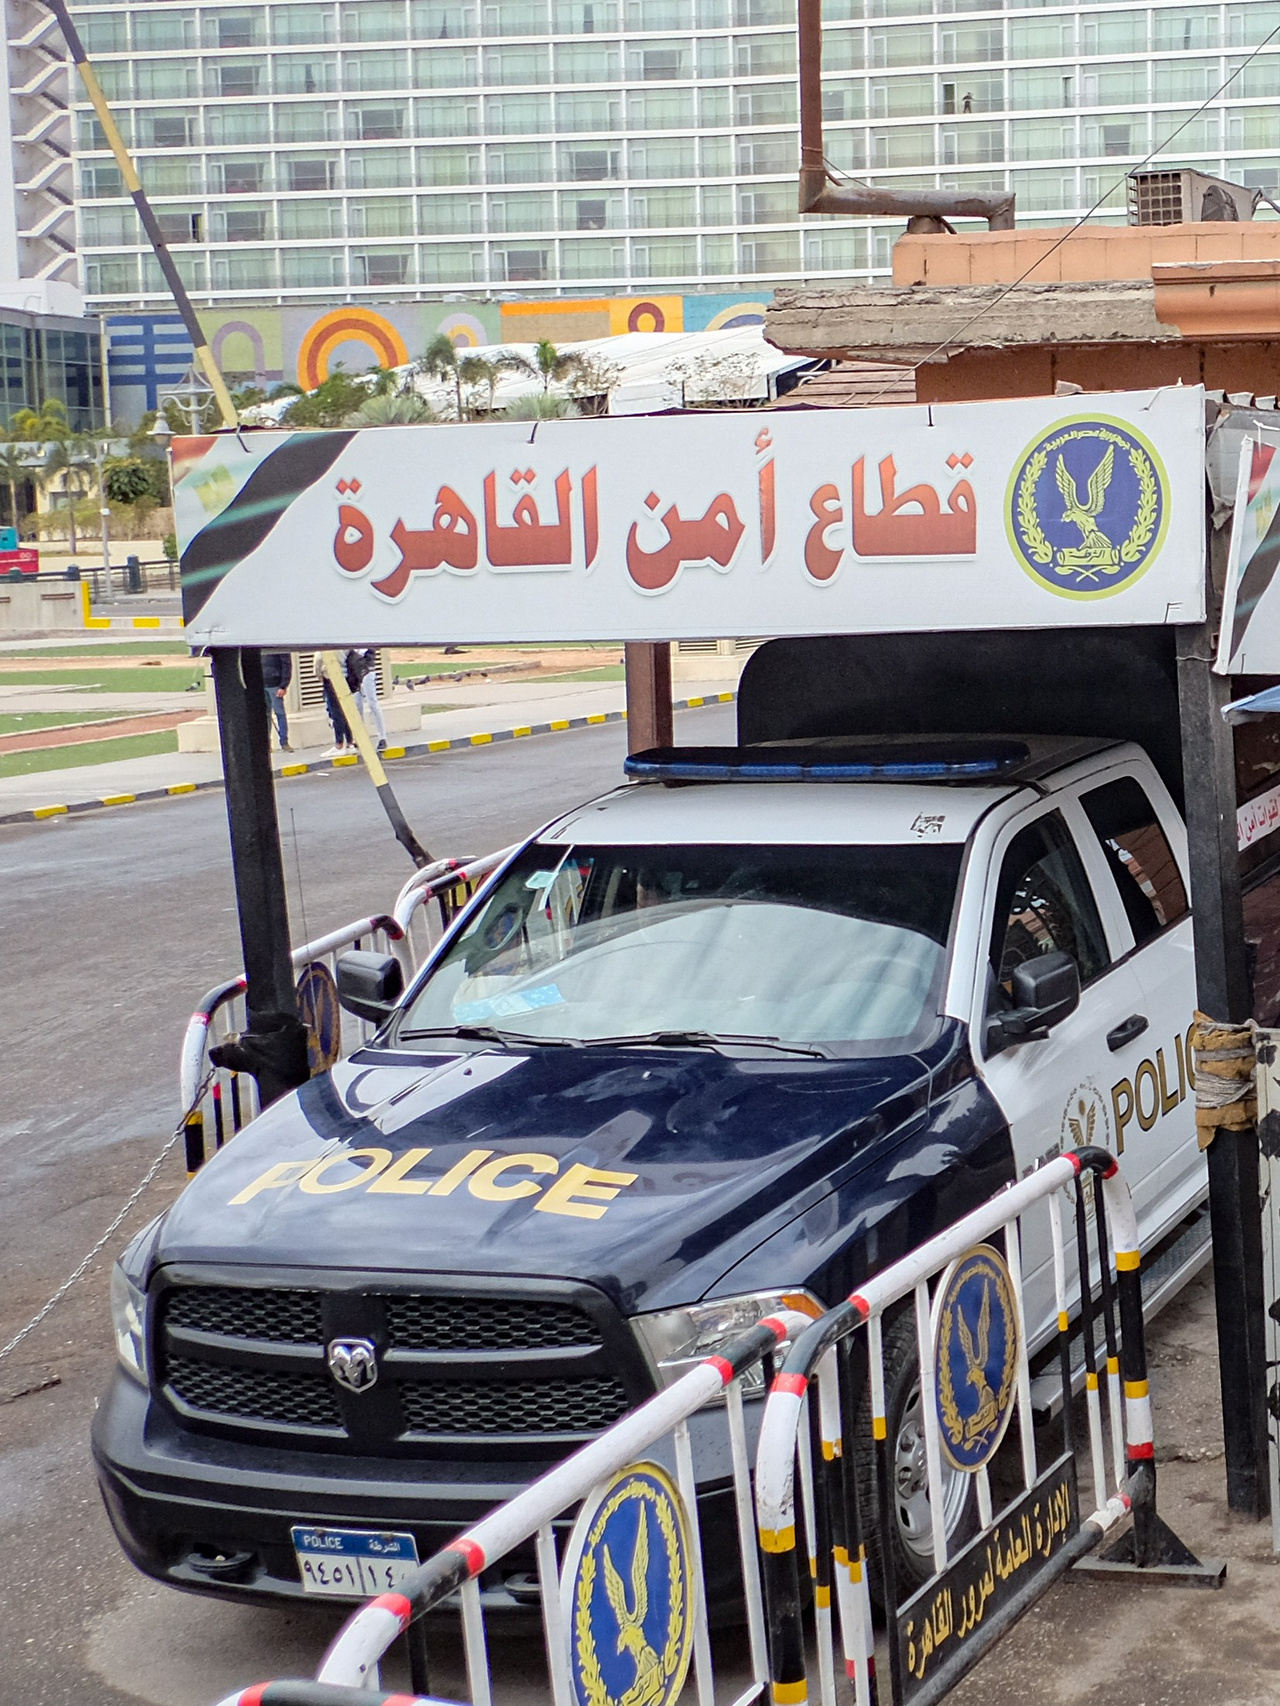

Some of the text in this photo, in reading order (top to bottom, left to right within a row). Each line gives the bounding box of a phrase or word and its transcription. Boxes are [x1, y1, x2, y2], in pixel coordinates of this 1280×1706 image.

[333, 425, 977, 599] قطاع أمن القاهرة
[1110, 1021, 1197, 1157] POLIC
[227, 1147, 639, 1220] POLICE
[303, 1535, 344, 1550] POLICE
[303, 1559, 355, 1588] ٩٤٥١
[368, 1539, 401, 1553] الشرطة
[906, 1480, 1070, 1680] الإدارة العامة لمرور القاهرة
